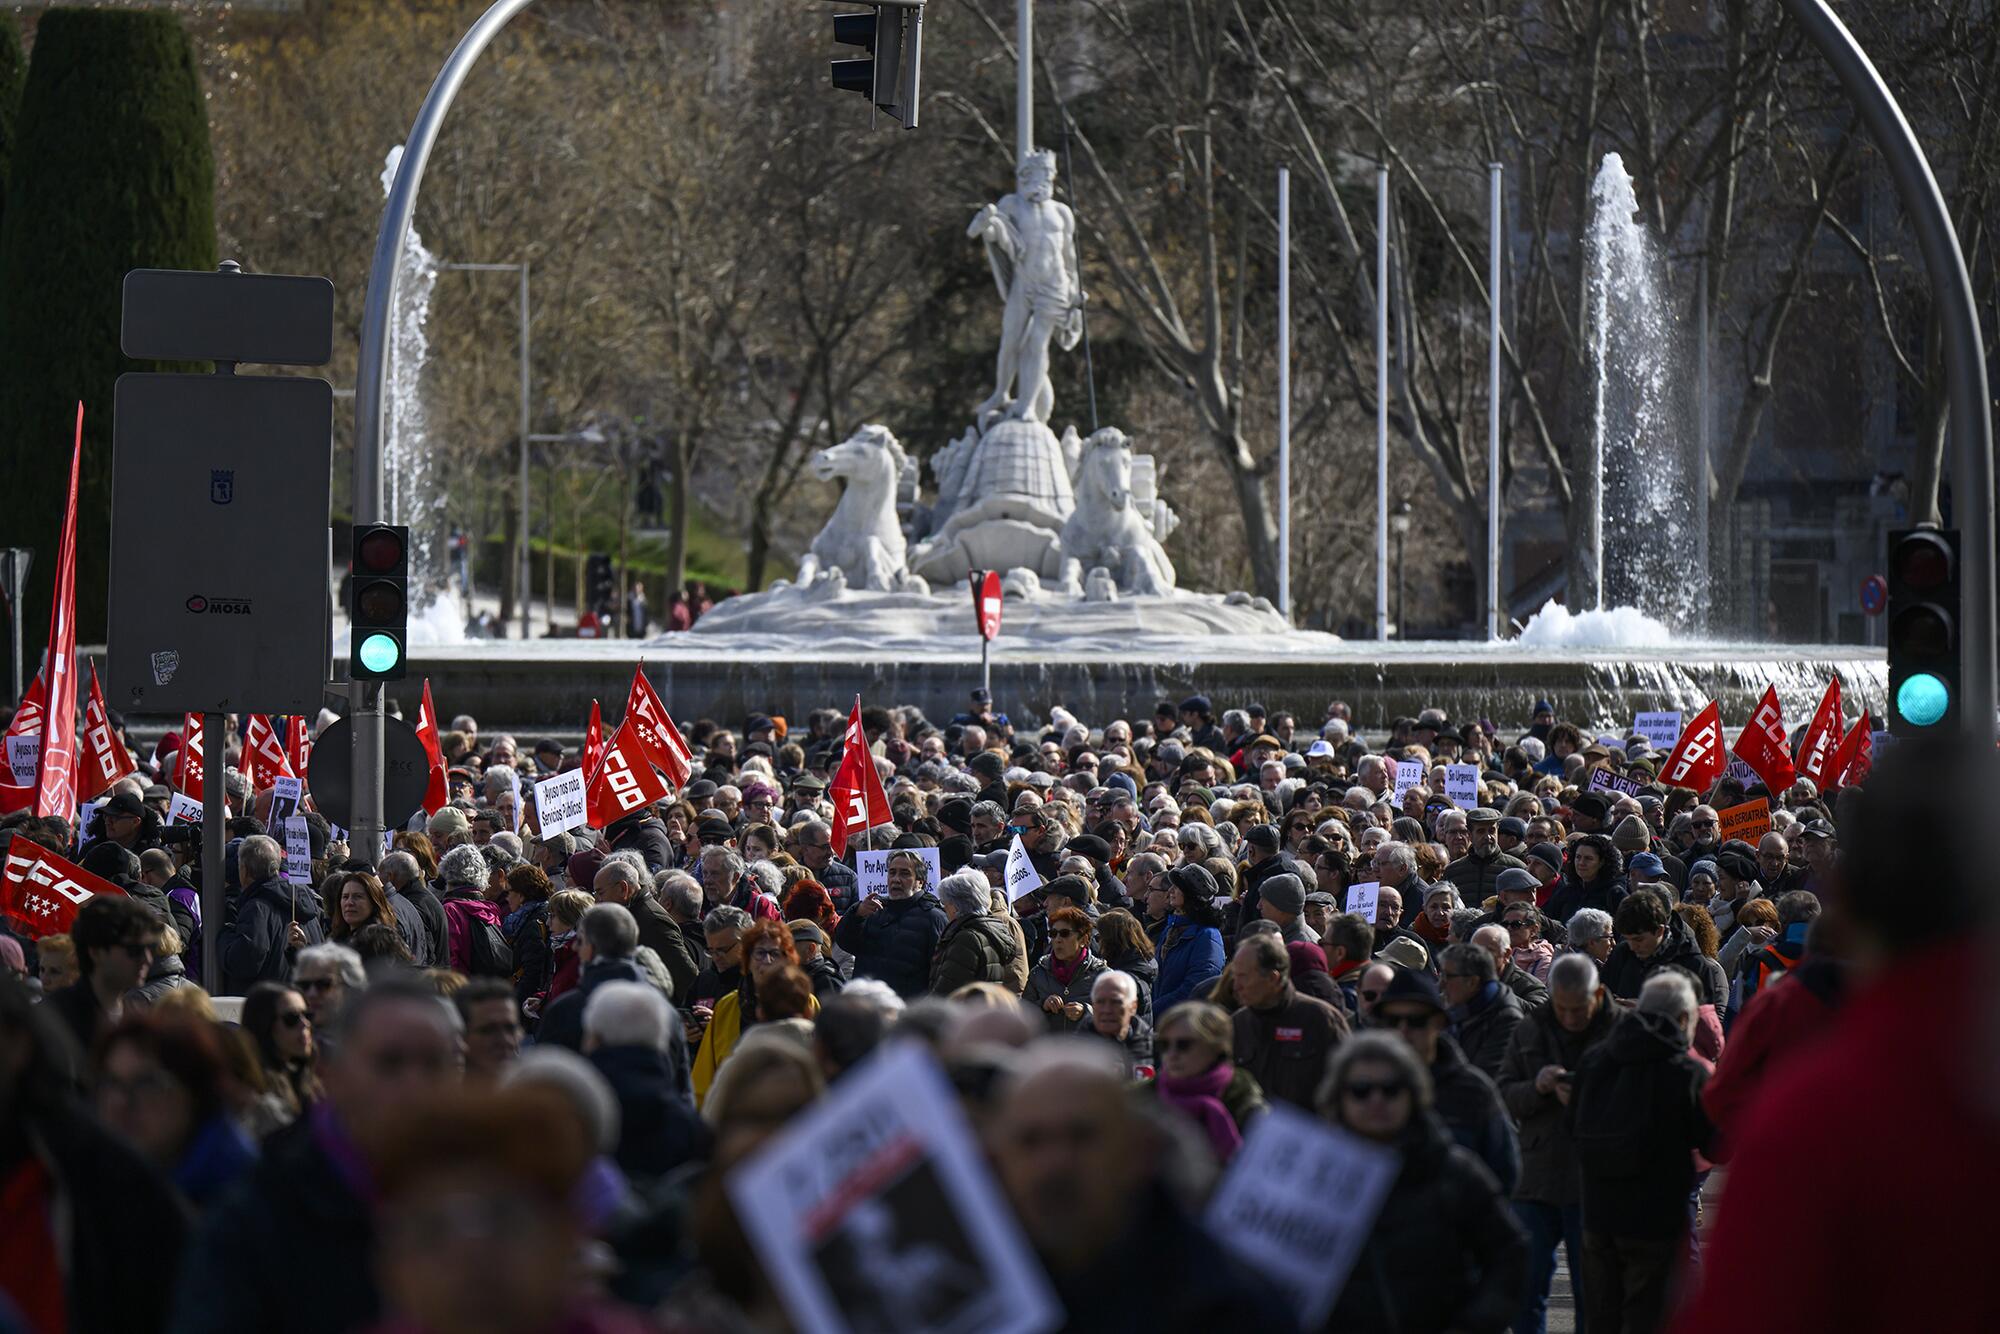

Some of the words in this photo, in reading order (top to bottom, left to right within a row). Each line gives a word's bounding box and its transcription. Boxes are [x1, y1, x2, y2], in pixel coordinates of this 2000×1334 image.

[210, 604, 252, 615] MOSA
[12, 762, 35, 776] Servicios
[604, 743, 647, 811] COO
[1594, 769, 1611, 786] SE
[559, 782, 569, 796] nos
[569, 775, 581, 793] roba
[541, 806, 563, 827] Servicios
[1722, 813, 1735, 829] MÁS
[1735, 807, 1769, 825] GERIATRAS
[864, 859, 875, 873] Por
[875, 859, 888, 876] Ayu
[3, 853, 95, 905] CCO
